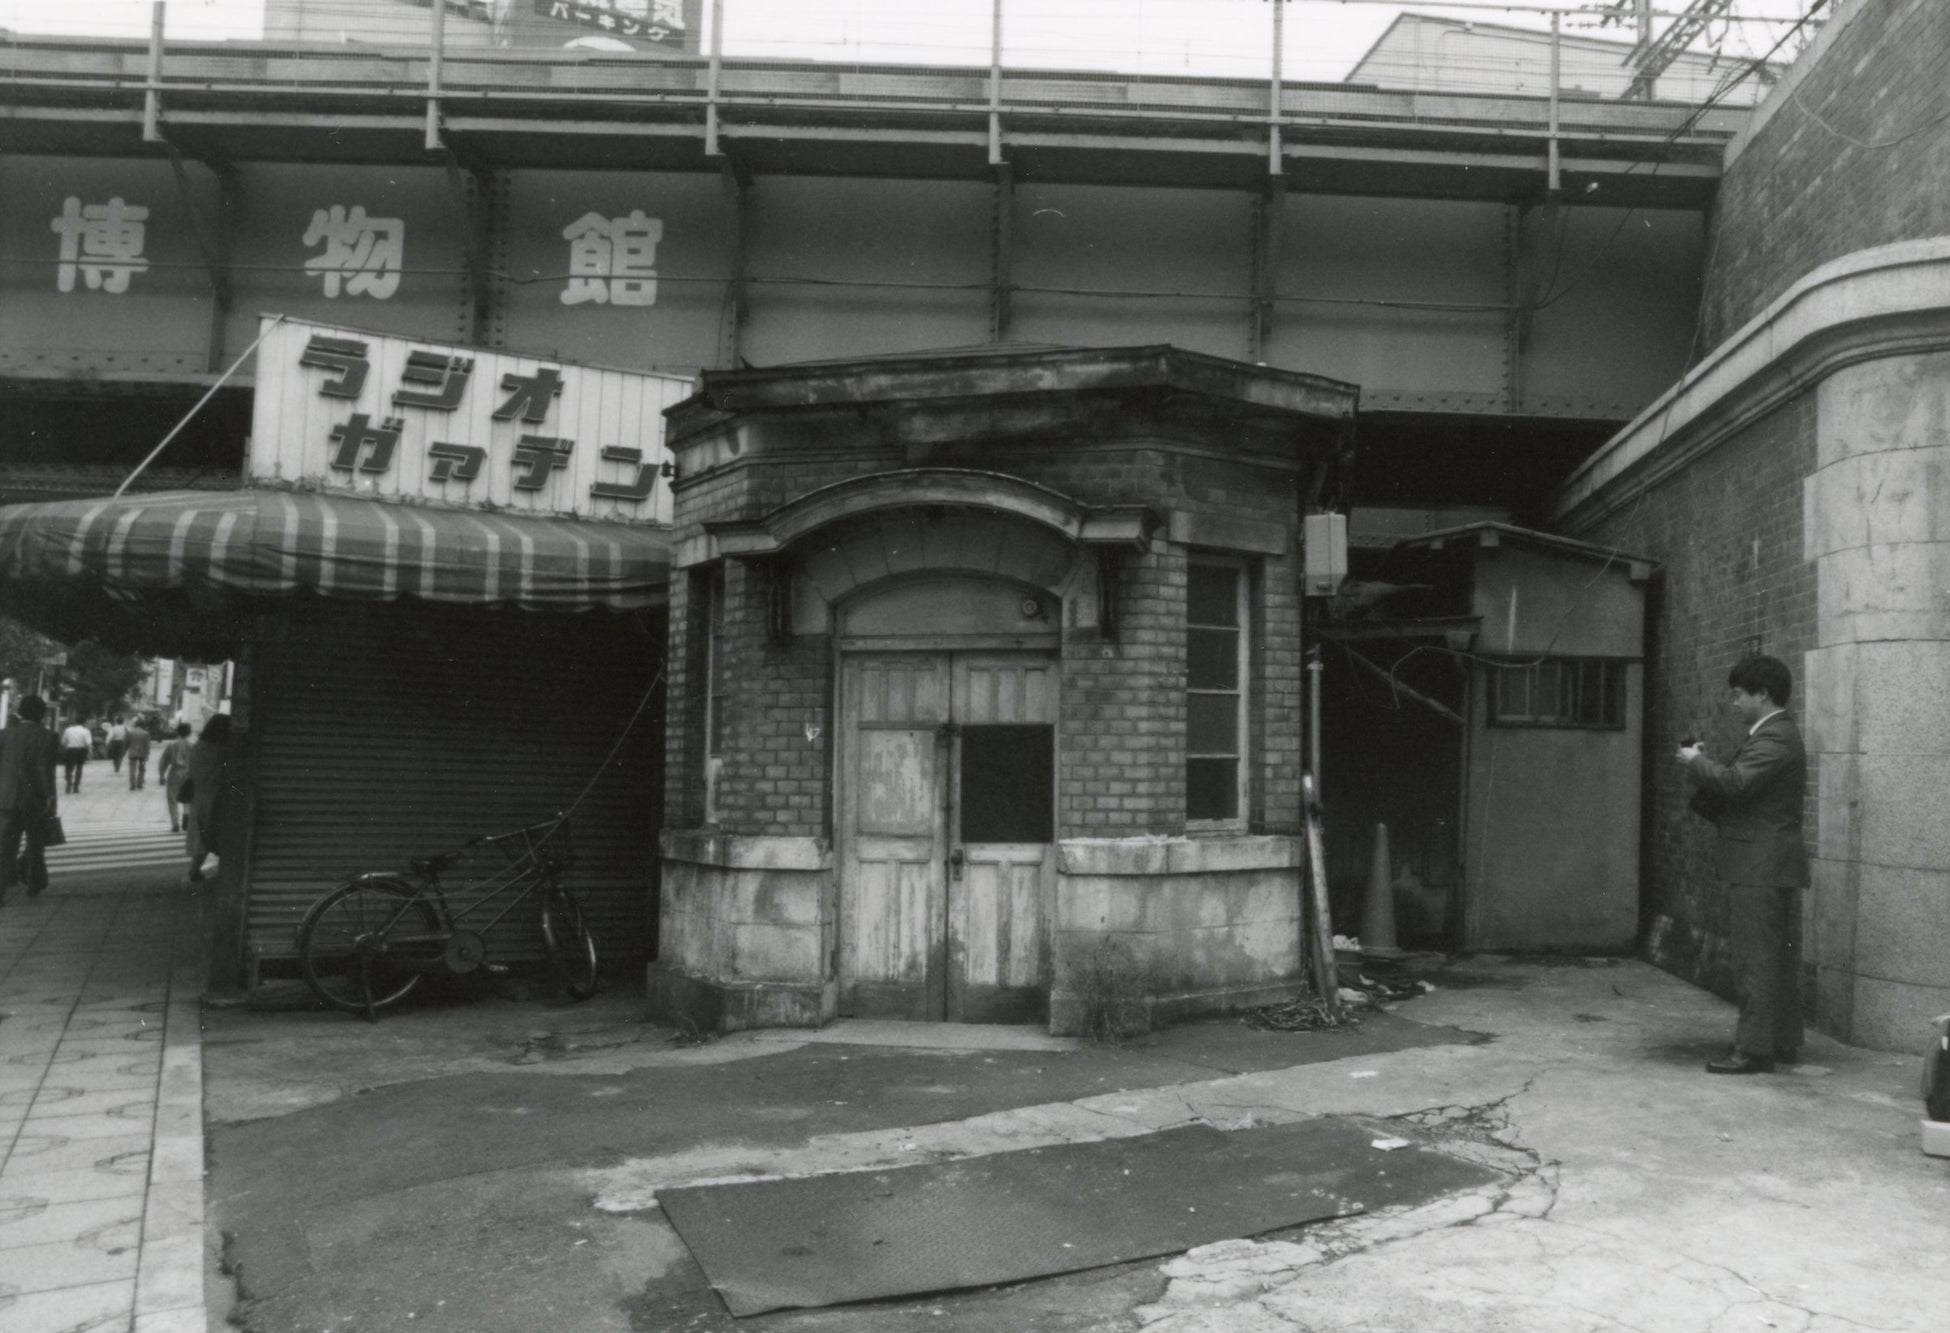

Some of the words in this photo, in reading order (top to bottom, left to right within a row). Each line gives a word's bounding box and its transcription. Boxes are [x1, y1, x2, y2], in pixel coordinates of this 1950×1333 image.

[51, 196, 662, 306] 博物館
[299, 335, 565, 422] ラジオ
